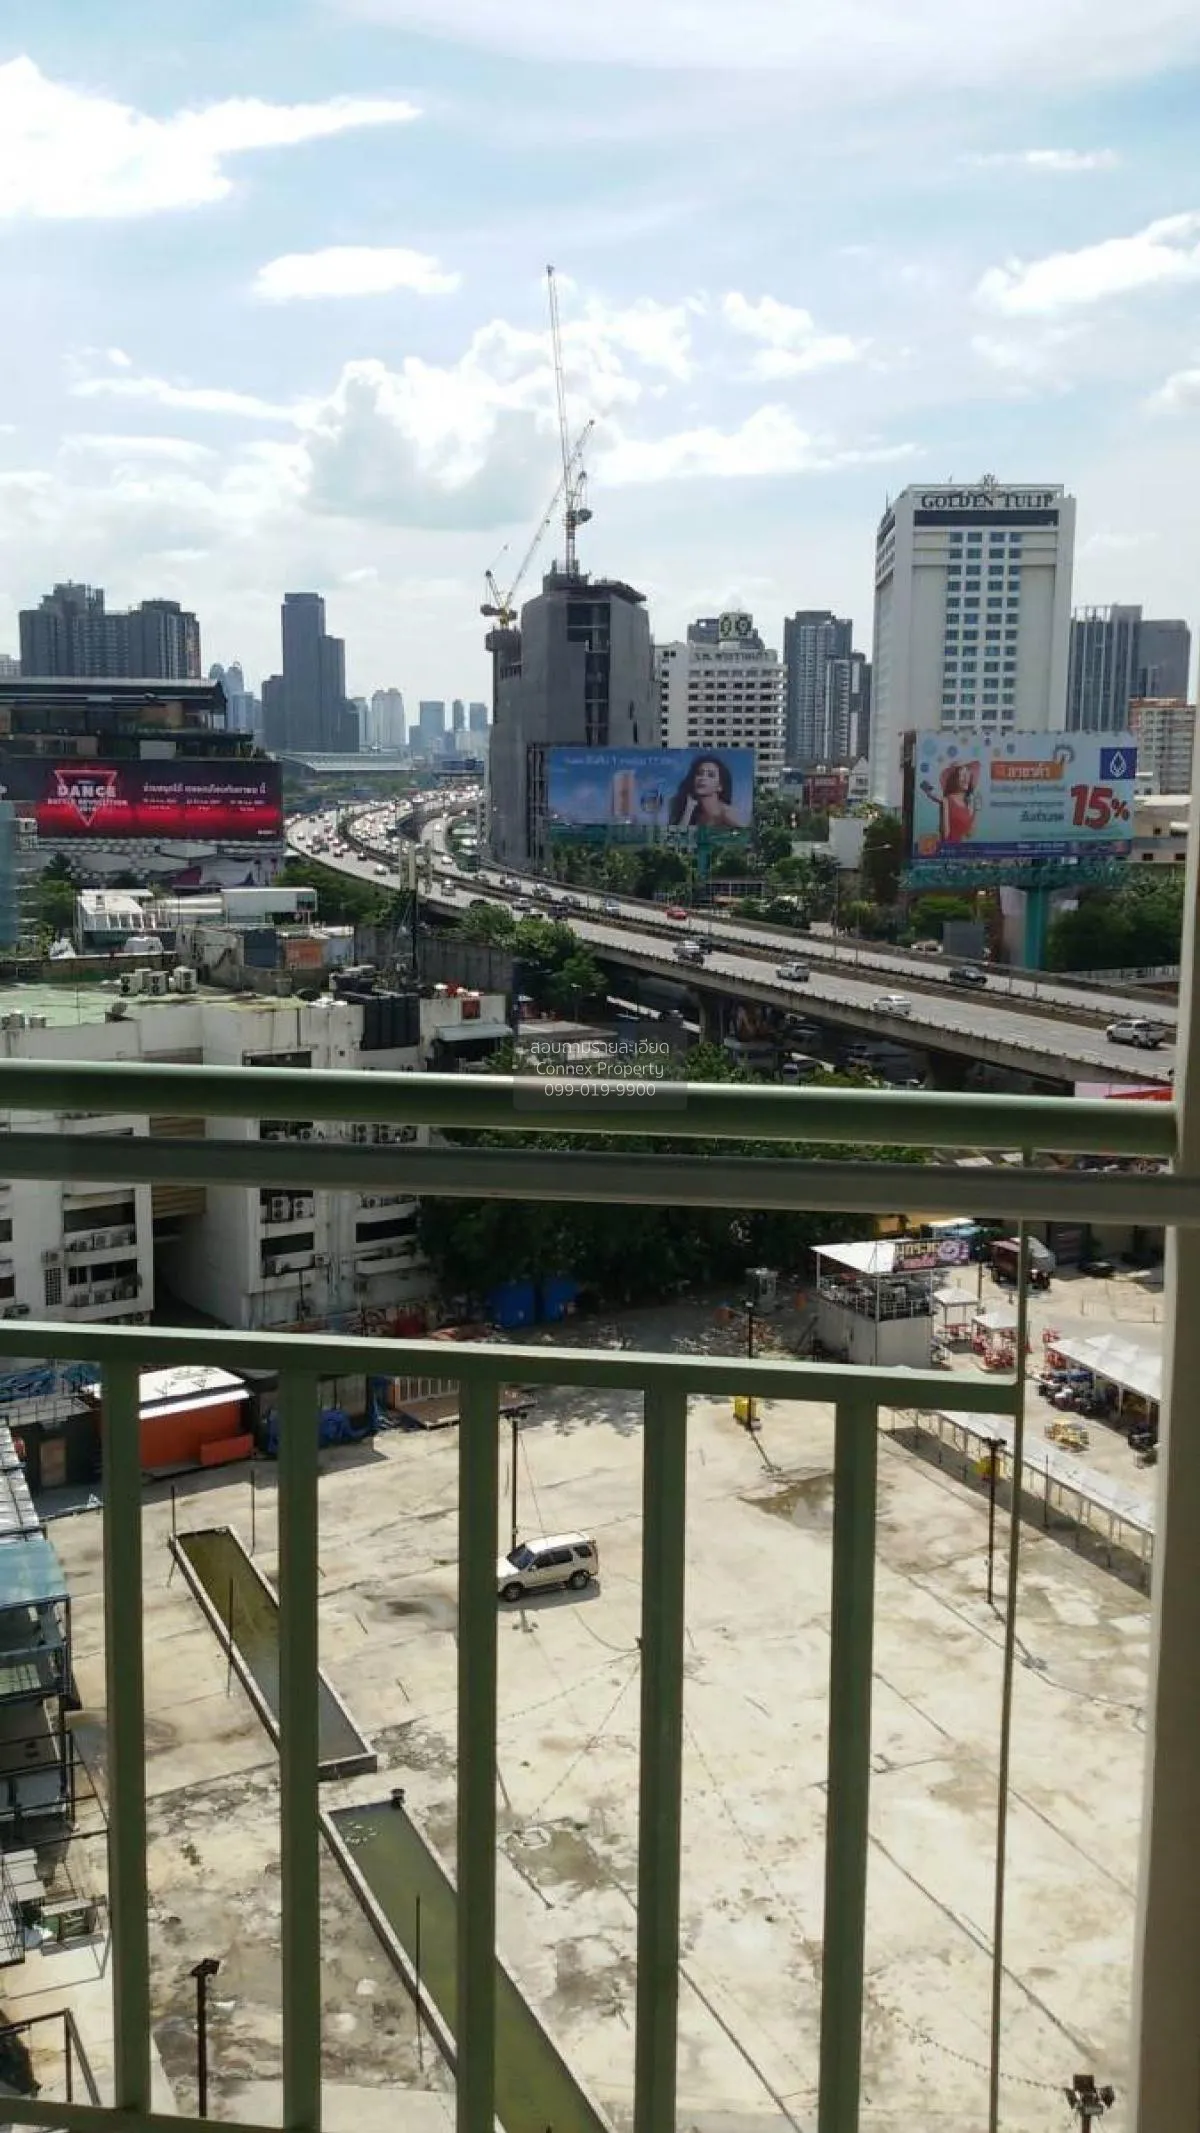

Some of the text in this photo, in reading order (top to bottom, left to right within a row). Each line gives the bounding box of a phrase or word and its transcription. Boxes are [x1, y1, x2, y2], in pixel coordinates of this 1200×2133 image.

[920, 492, 1056, 509] GOLDEN TULIP
[57, 784, 117, 798] DANCE
[1070, 783, 1131, 831] 15%
